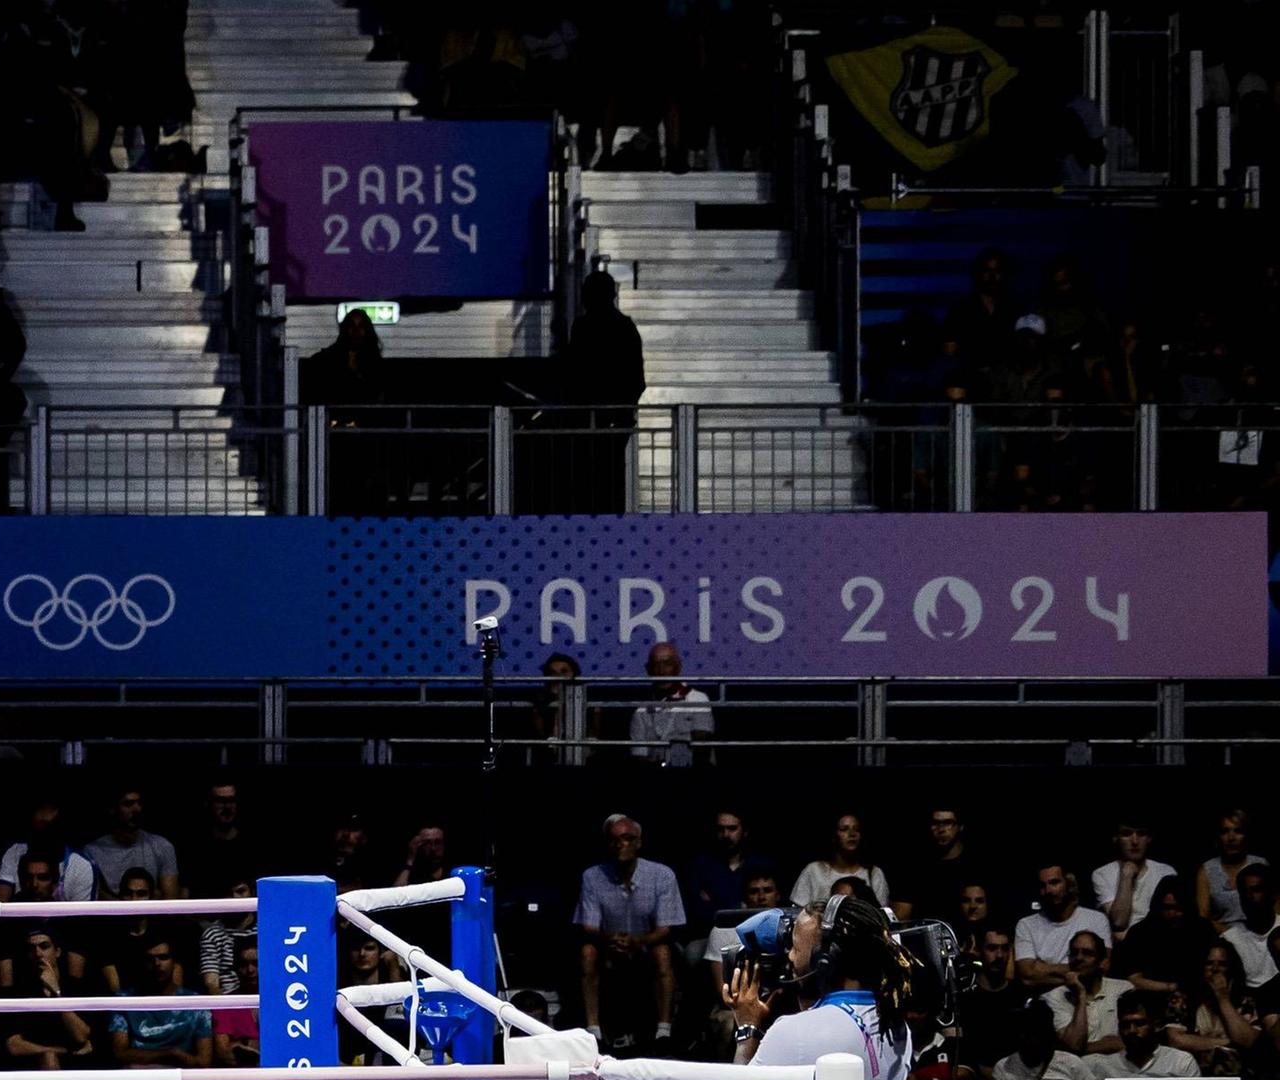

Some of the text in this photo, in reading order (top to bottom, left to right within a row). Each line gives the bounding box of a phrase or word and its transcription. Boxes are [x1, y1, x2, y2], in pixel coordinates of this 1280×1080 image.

[323, 213, 479, 254] 2024
[841, 575, 1131, 643] 2024
[284, 926, 311, 1038] 2024
